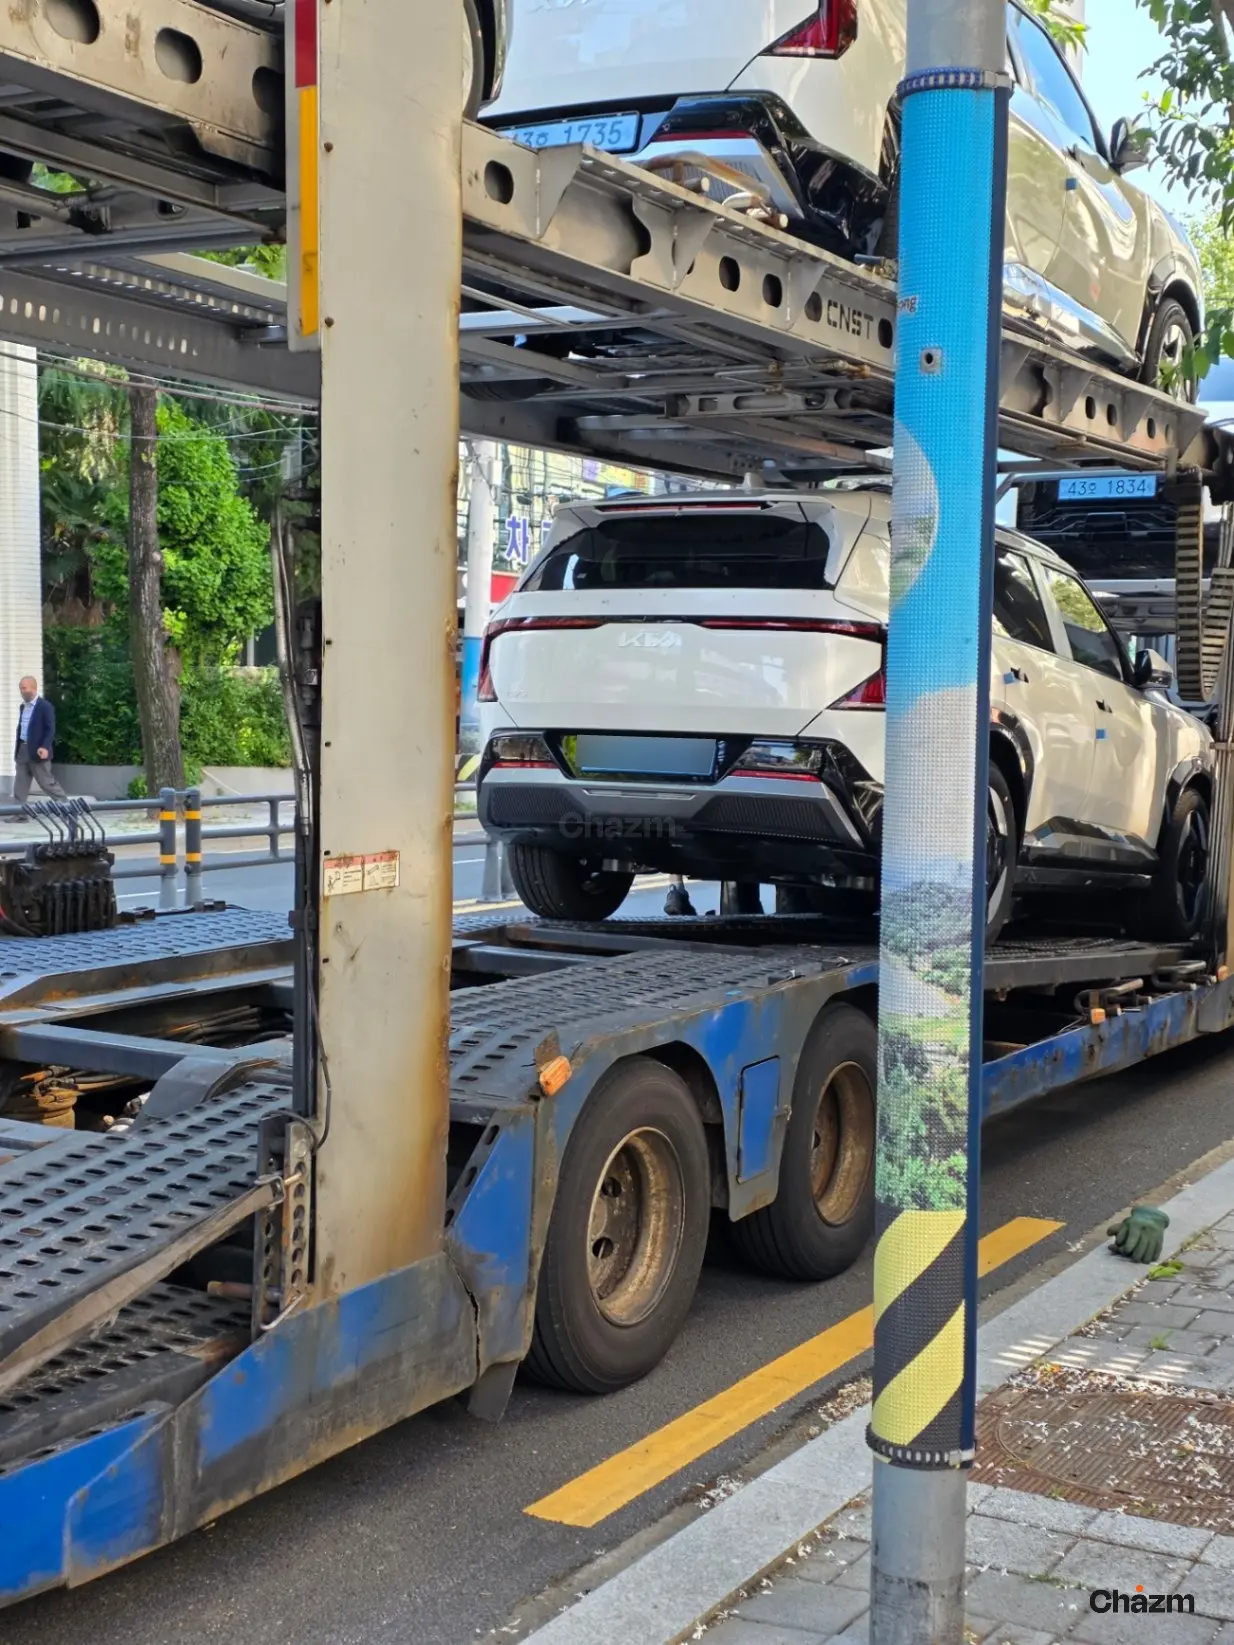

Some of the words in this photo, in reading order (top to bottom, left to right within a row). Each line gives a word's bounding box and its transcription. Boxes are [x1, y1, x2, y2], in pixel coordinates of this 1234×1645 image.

[563, 120, 623, 146] 1735
[827, 299, 874, 340] CNST
[1108, 479, 1146, 494] 1834
